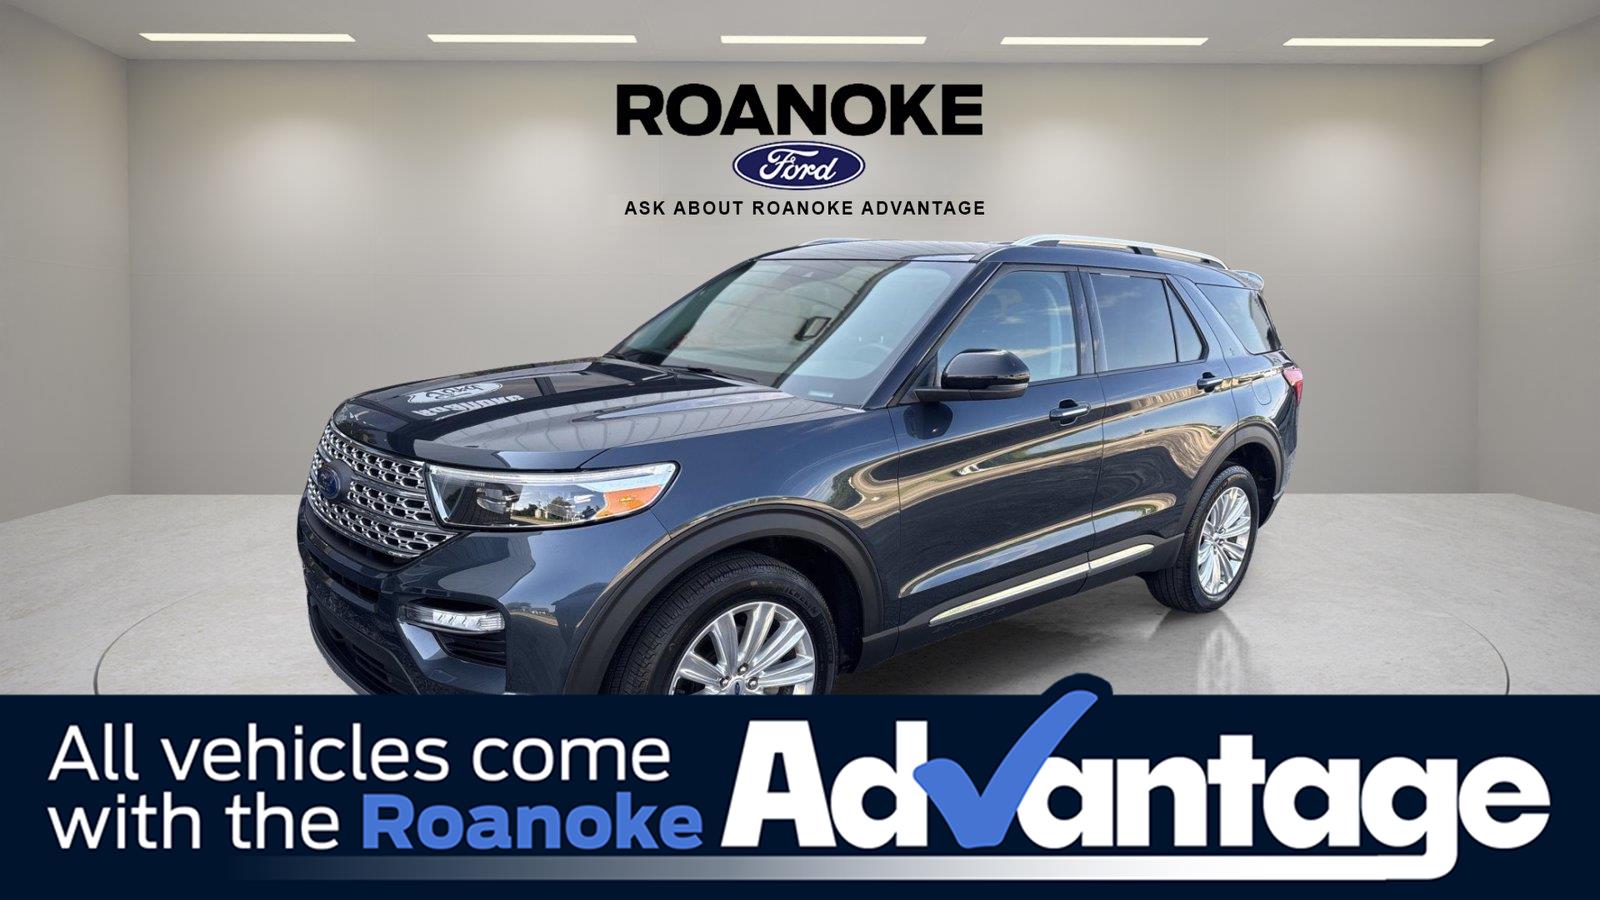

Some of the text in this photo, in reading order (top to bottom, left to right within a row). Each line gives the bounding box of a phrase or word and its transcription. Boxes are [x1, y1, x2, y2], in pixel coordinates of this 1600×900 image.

[616, 83, 983, 137] ROANOKE
[759, 148, 840, 181] Ford
[624, 200, 985, 216] ASK ABOUT ROANOKE ADVANTAGE
